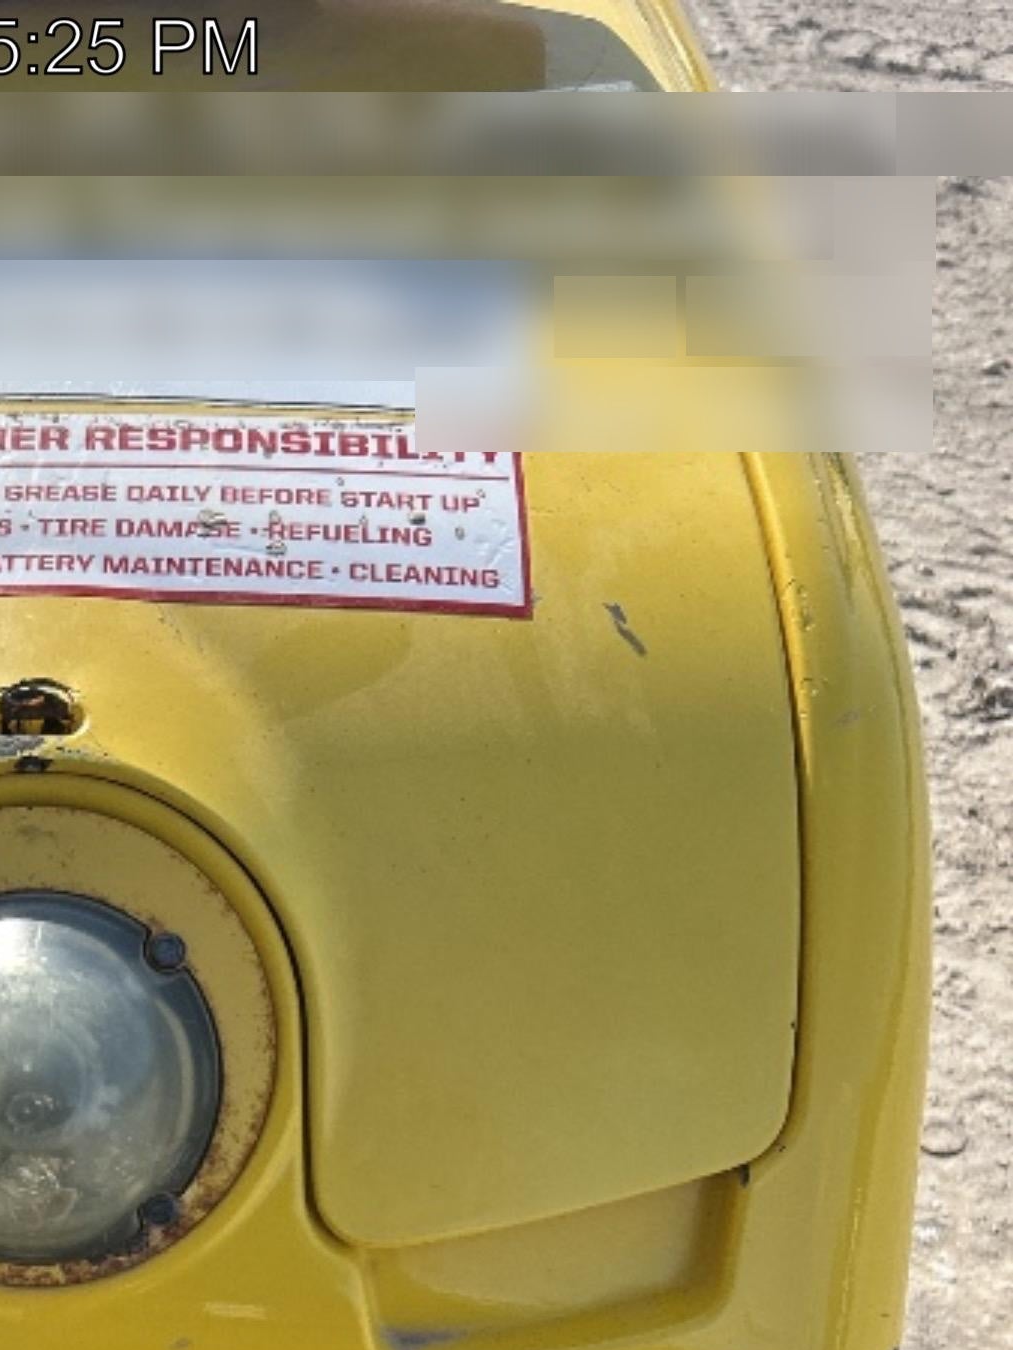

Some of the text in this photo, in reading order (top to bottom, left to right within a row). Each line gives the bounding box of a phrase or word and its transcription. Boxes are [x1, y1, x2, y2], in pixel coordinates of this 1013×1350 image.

[5, 484, 117, 502] GREASE
[127, 484, 210, 502] DAILY
[221, 487, 330, 506] BEFORE
[340, 490, 434, 510] START
[441, 495, 480, 512] UP
[37, 518, 106, 536] TIRE
[268, 521, 433, 546] REFUELING
[103, 556, 324, 580] MAINTENANCE
[349, 562, 500, 588] CLEANING
